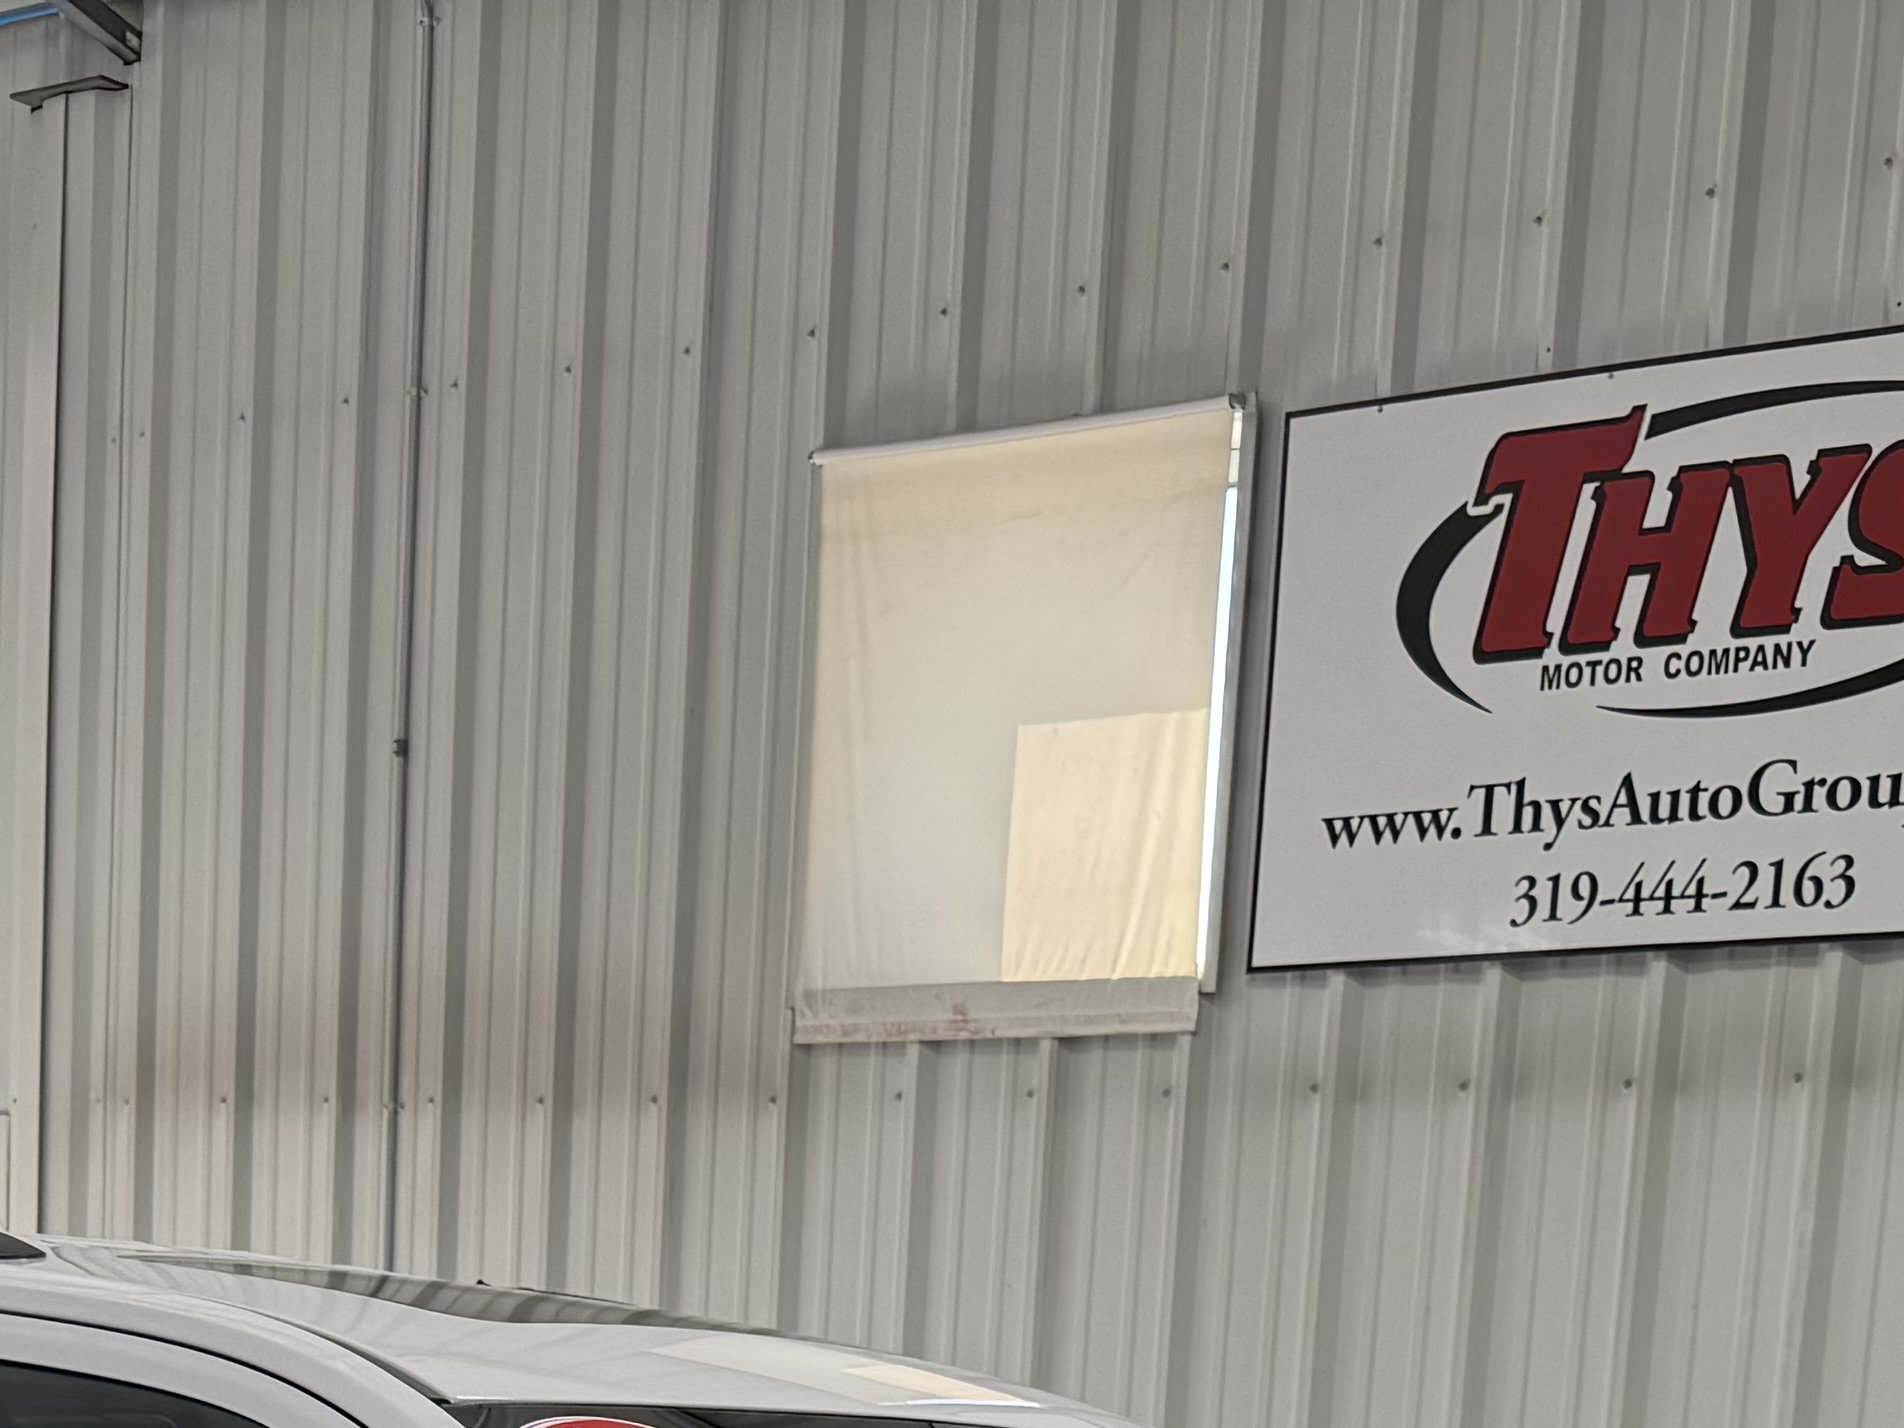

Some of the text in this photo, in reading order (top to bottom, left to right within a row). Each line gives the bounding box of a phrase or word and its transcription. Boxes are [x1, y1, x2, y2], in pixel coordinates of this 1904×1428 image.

[1539, 639, 1817, 692] MOTOR COMPANY
[1508, 850, 1857, 928] 319-444-2163
